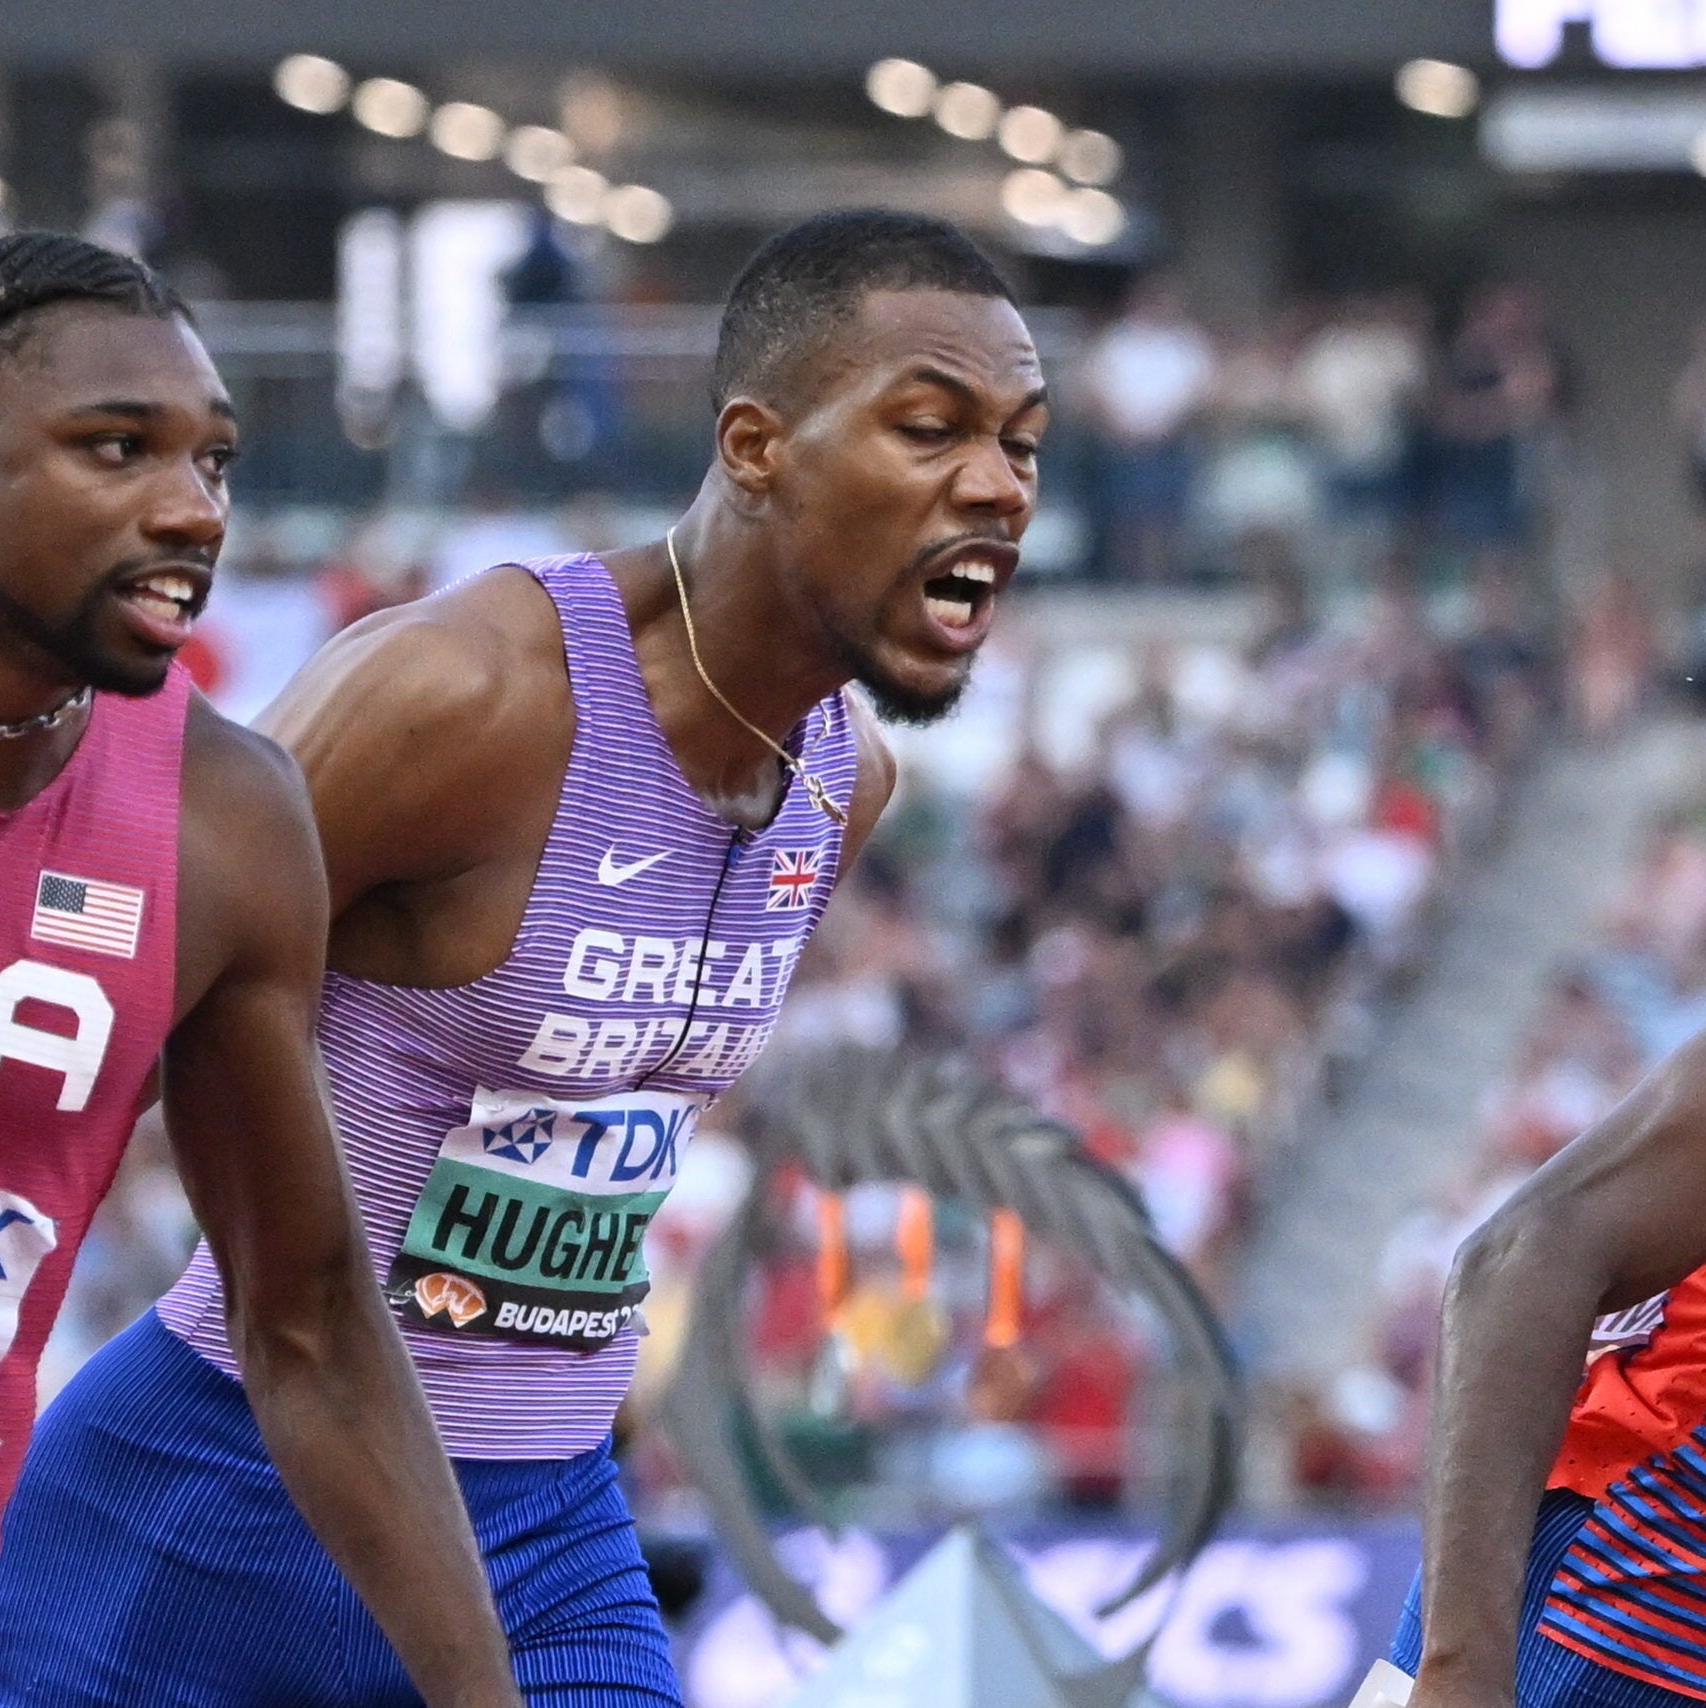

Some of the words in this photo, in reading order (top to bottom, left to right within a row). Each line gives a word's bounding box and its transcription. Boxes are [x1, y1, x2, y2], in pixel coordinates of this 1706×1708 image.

[562, 928, 802, 1008] GREAT
[571, 1104, 696, 1182] TDK
[431, 1184, 650, 1282] HUGHE
